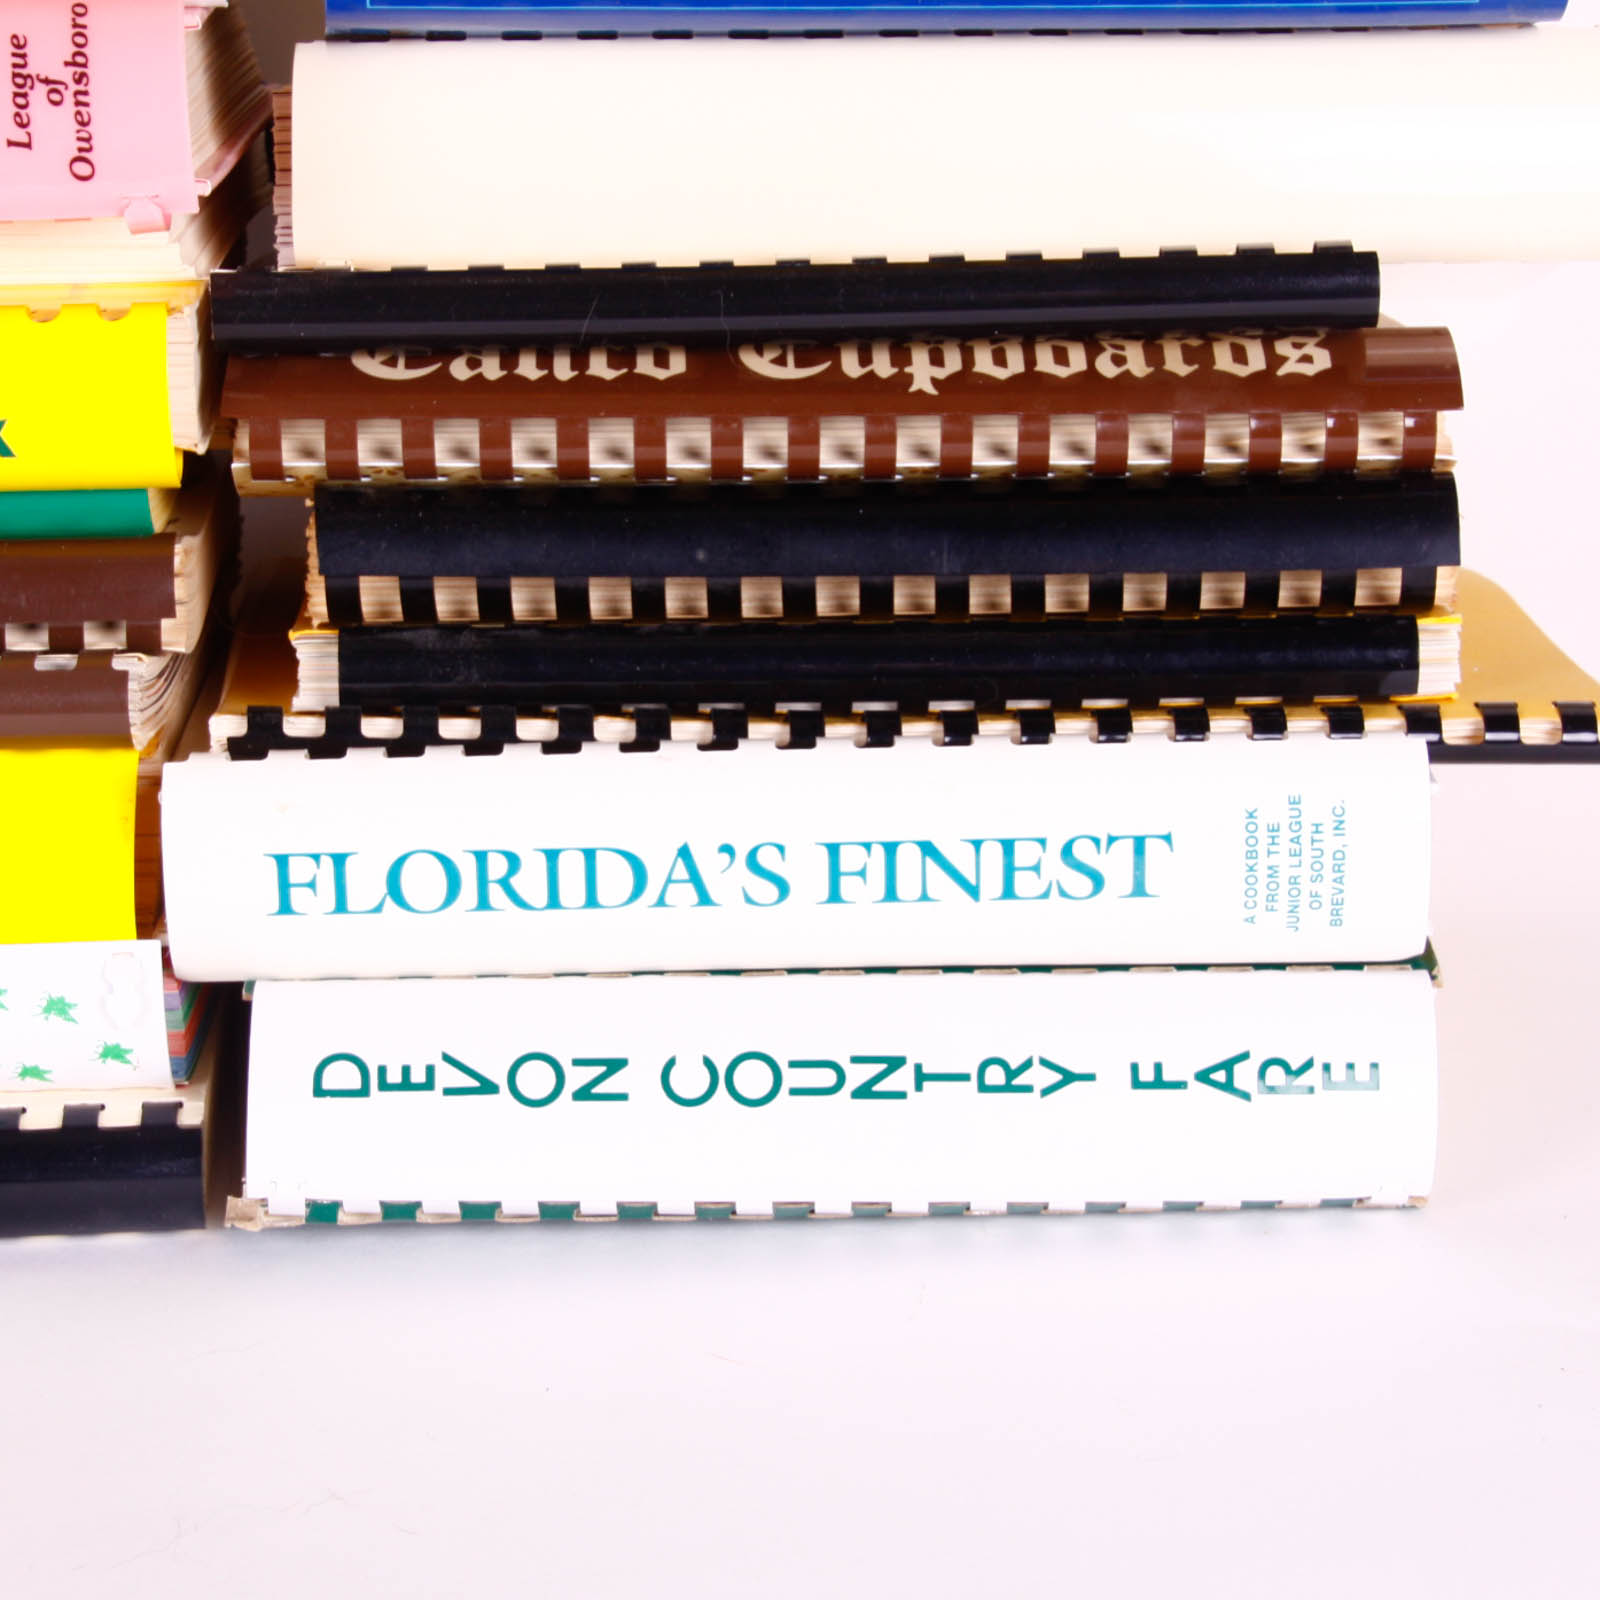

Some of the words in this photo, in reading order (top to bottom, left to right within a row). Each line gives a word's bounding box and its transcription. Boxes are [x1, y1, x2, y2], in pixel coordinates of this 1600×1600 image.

[6, 33, 35, 151] League
[36, 73, 68, 107] of
[63, 2, 96, 182] Owensboro
[1266, 822, 1281, 859] THE
[1287, 794, 1303, 868] LEAGUE
[1331, 799, 1346, 837] INC.
[263, 840, 791, 917] FLORIDA’S
[815, 831, 1174, 905] FINEST
[1244, 807, 1259, 910] COOKBOOK
[1310, 821, 1325, 884] SOUTH
[1265, 864, 1280, 912] FROM
[1286, 874, 1302, 932] JUNIOR
[1308, 889, 1323, 911] OF
[1329, 844, 1348, 928] BREVARD,
[1243, 914, 1256, 925] A
[312, 1050, 630, 1109] DEVON
[659, 1049, 1097, 1109] COUNTRY
[1130, 1049, 1381, 1103] FARE
